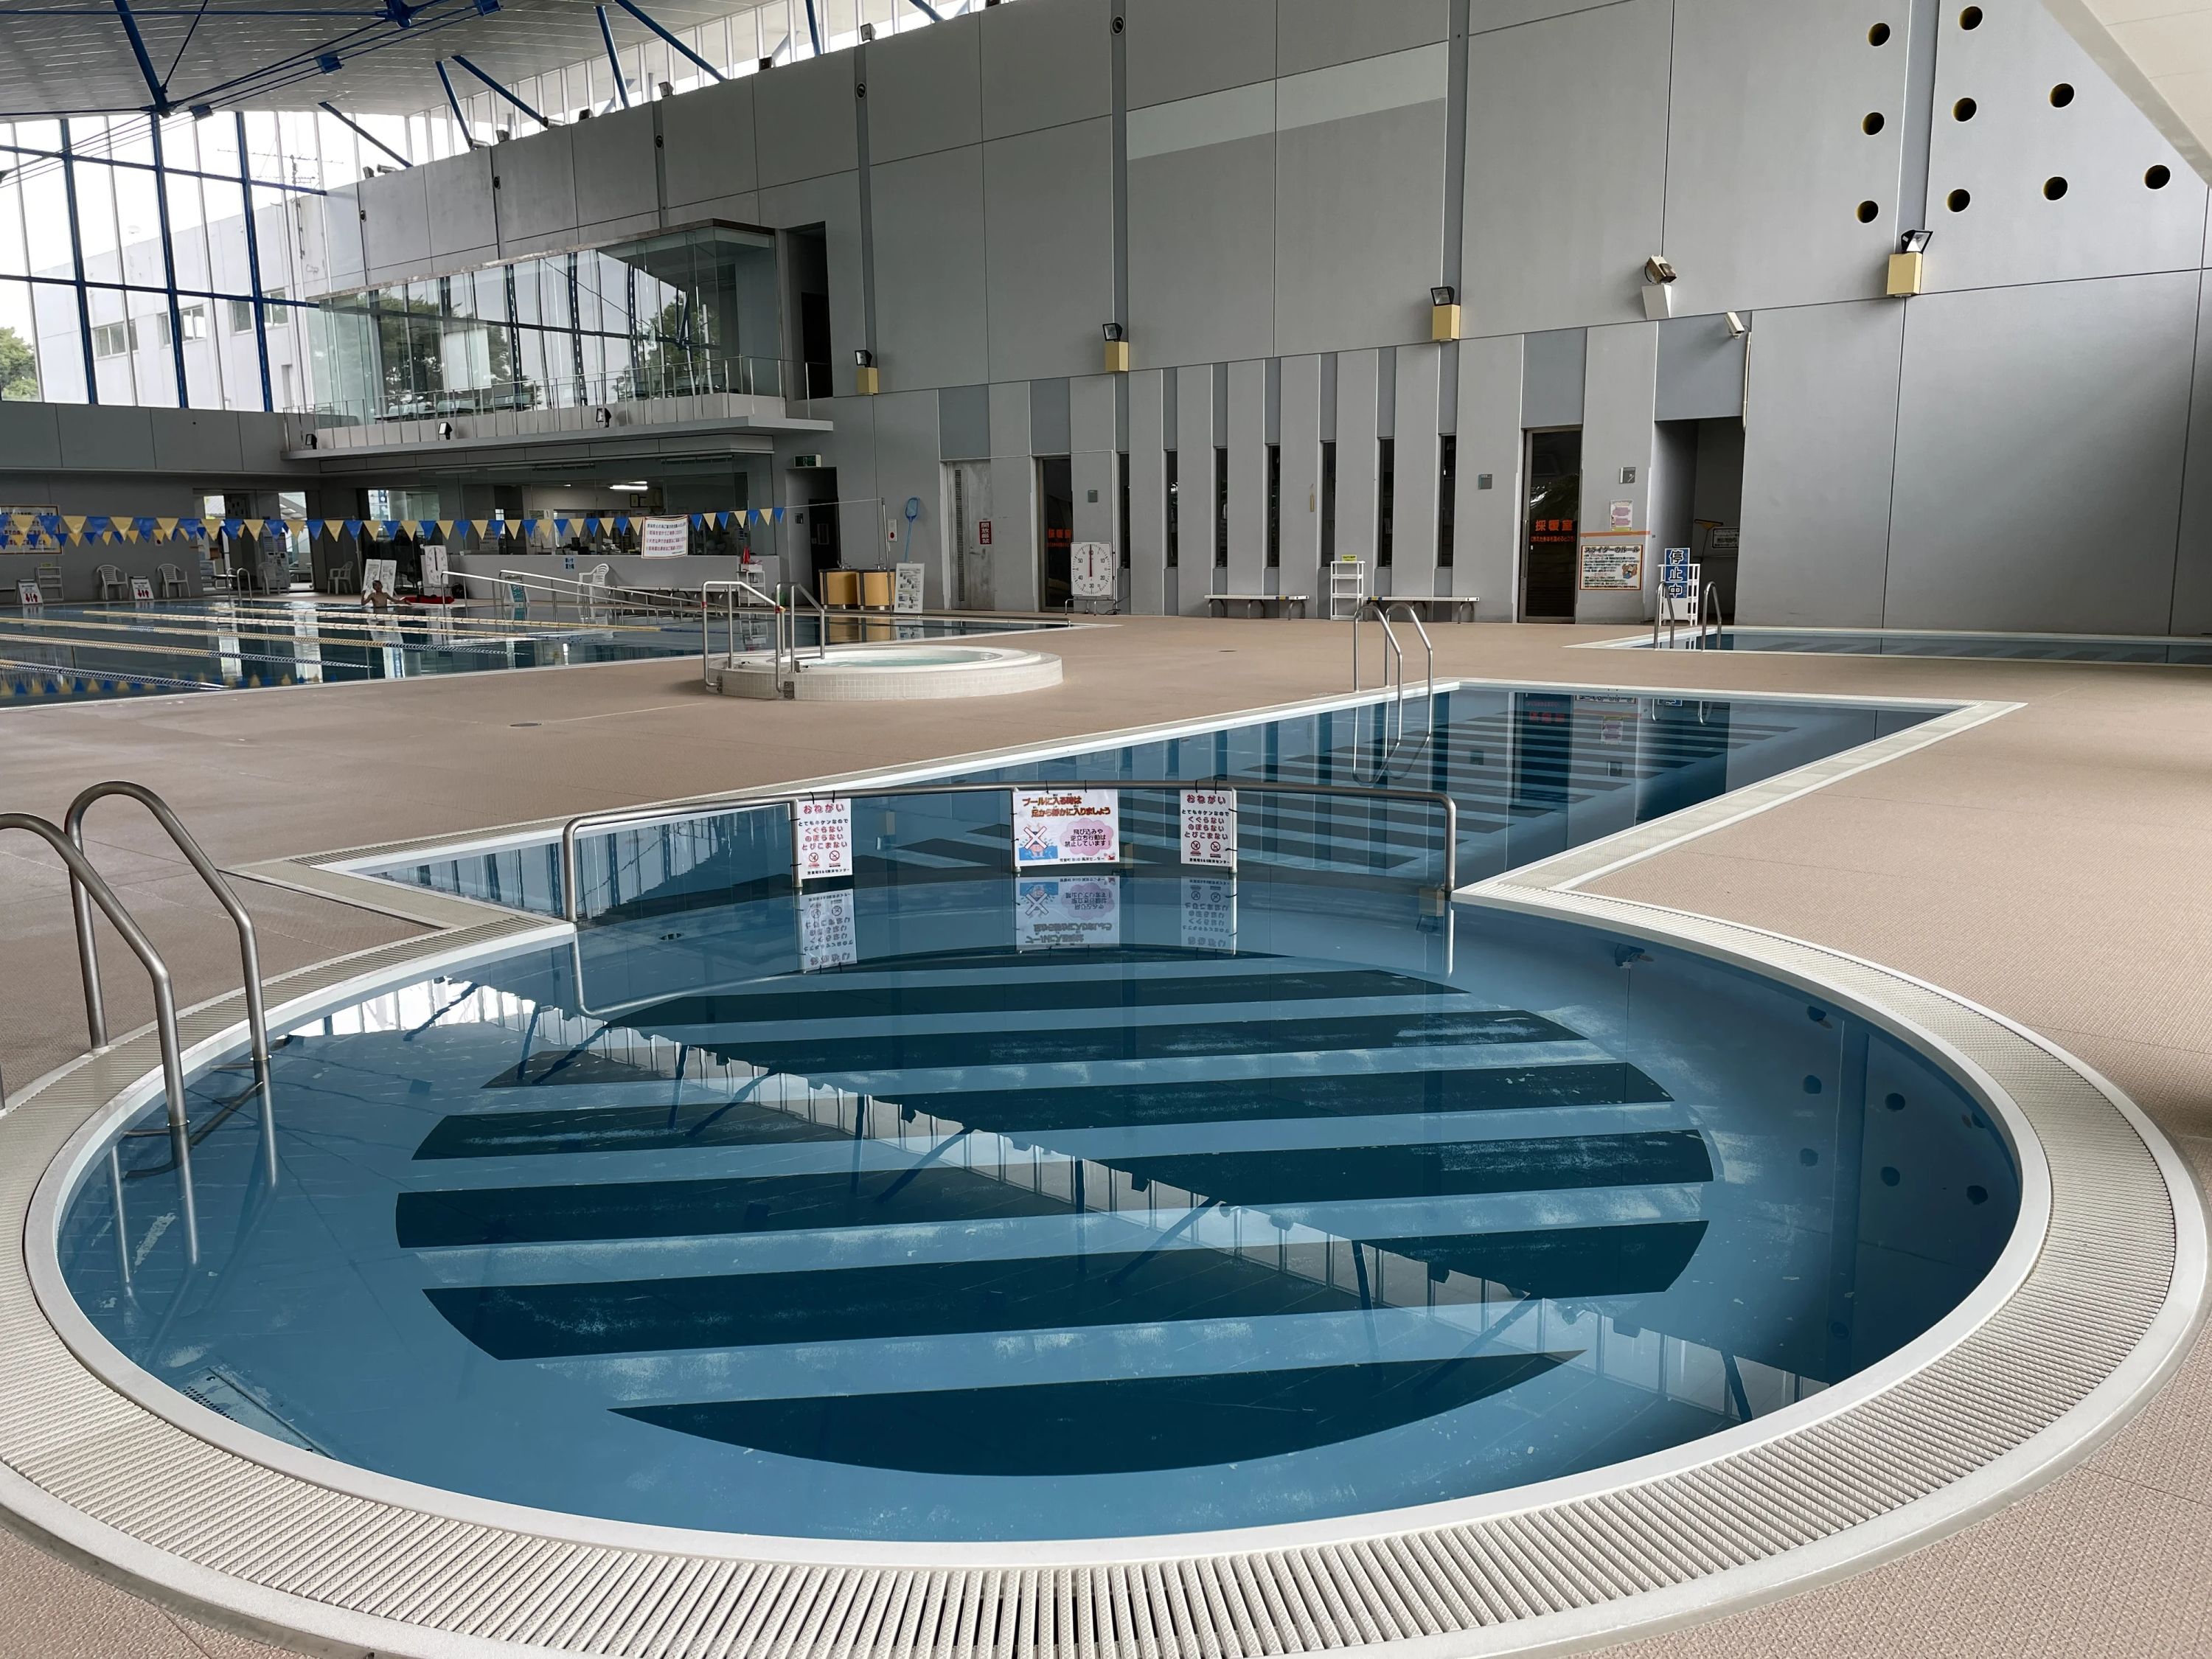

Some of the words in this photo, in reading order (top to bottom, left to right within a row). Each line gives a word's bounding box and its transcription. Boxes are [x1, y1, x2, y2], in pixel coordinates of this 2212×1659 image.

[1669, 549, 1684, 598] 停止中
[1022, 796, 1082, 807] プールに入る時は
[1186, 794, 1226, 804] おねがい
[804, 803, 844, 814] おねがい
[1032, 807, 1110, 818] 足から静かに入りましょう
[1188, 816, 1225, 824] くぐらない
[805, 826, 844, 834] くぐらない
[805, 834, 844, 842] のぼらない
[1184, 832, 1228, 840] とびこまない
[801, 841, 847, 851] とびこまない
